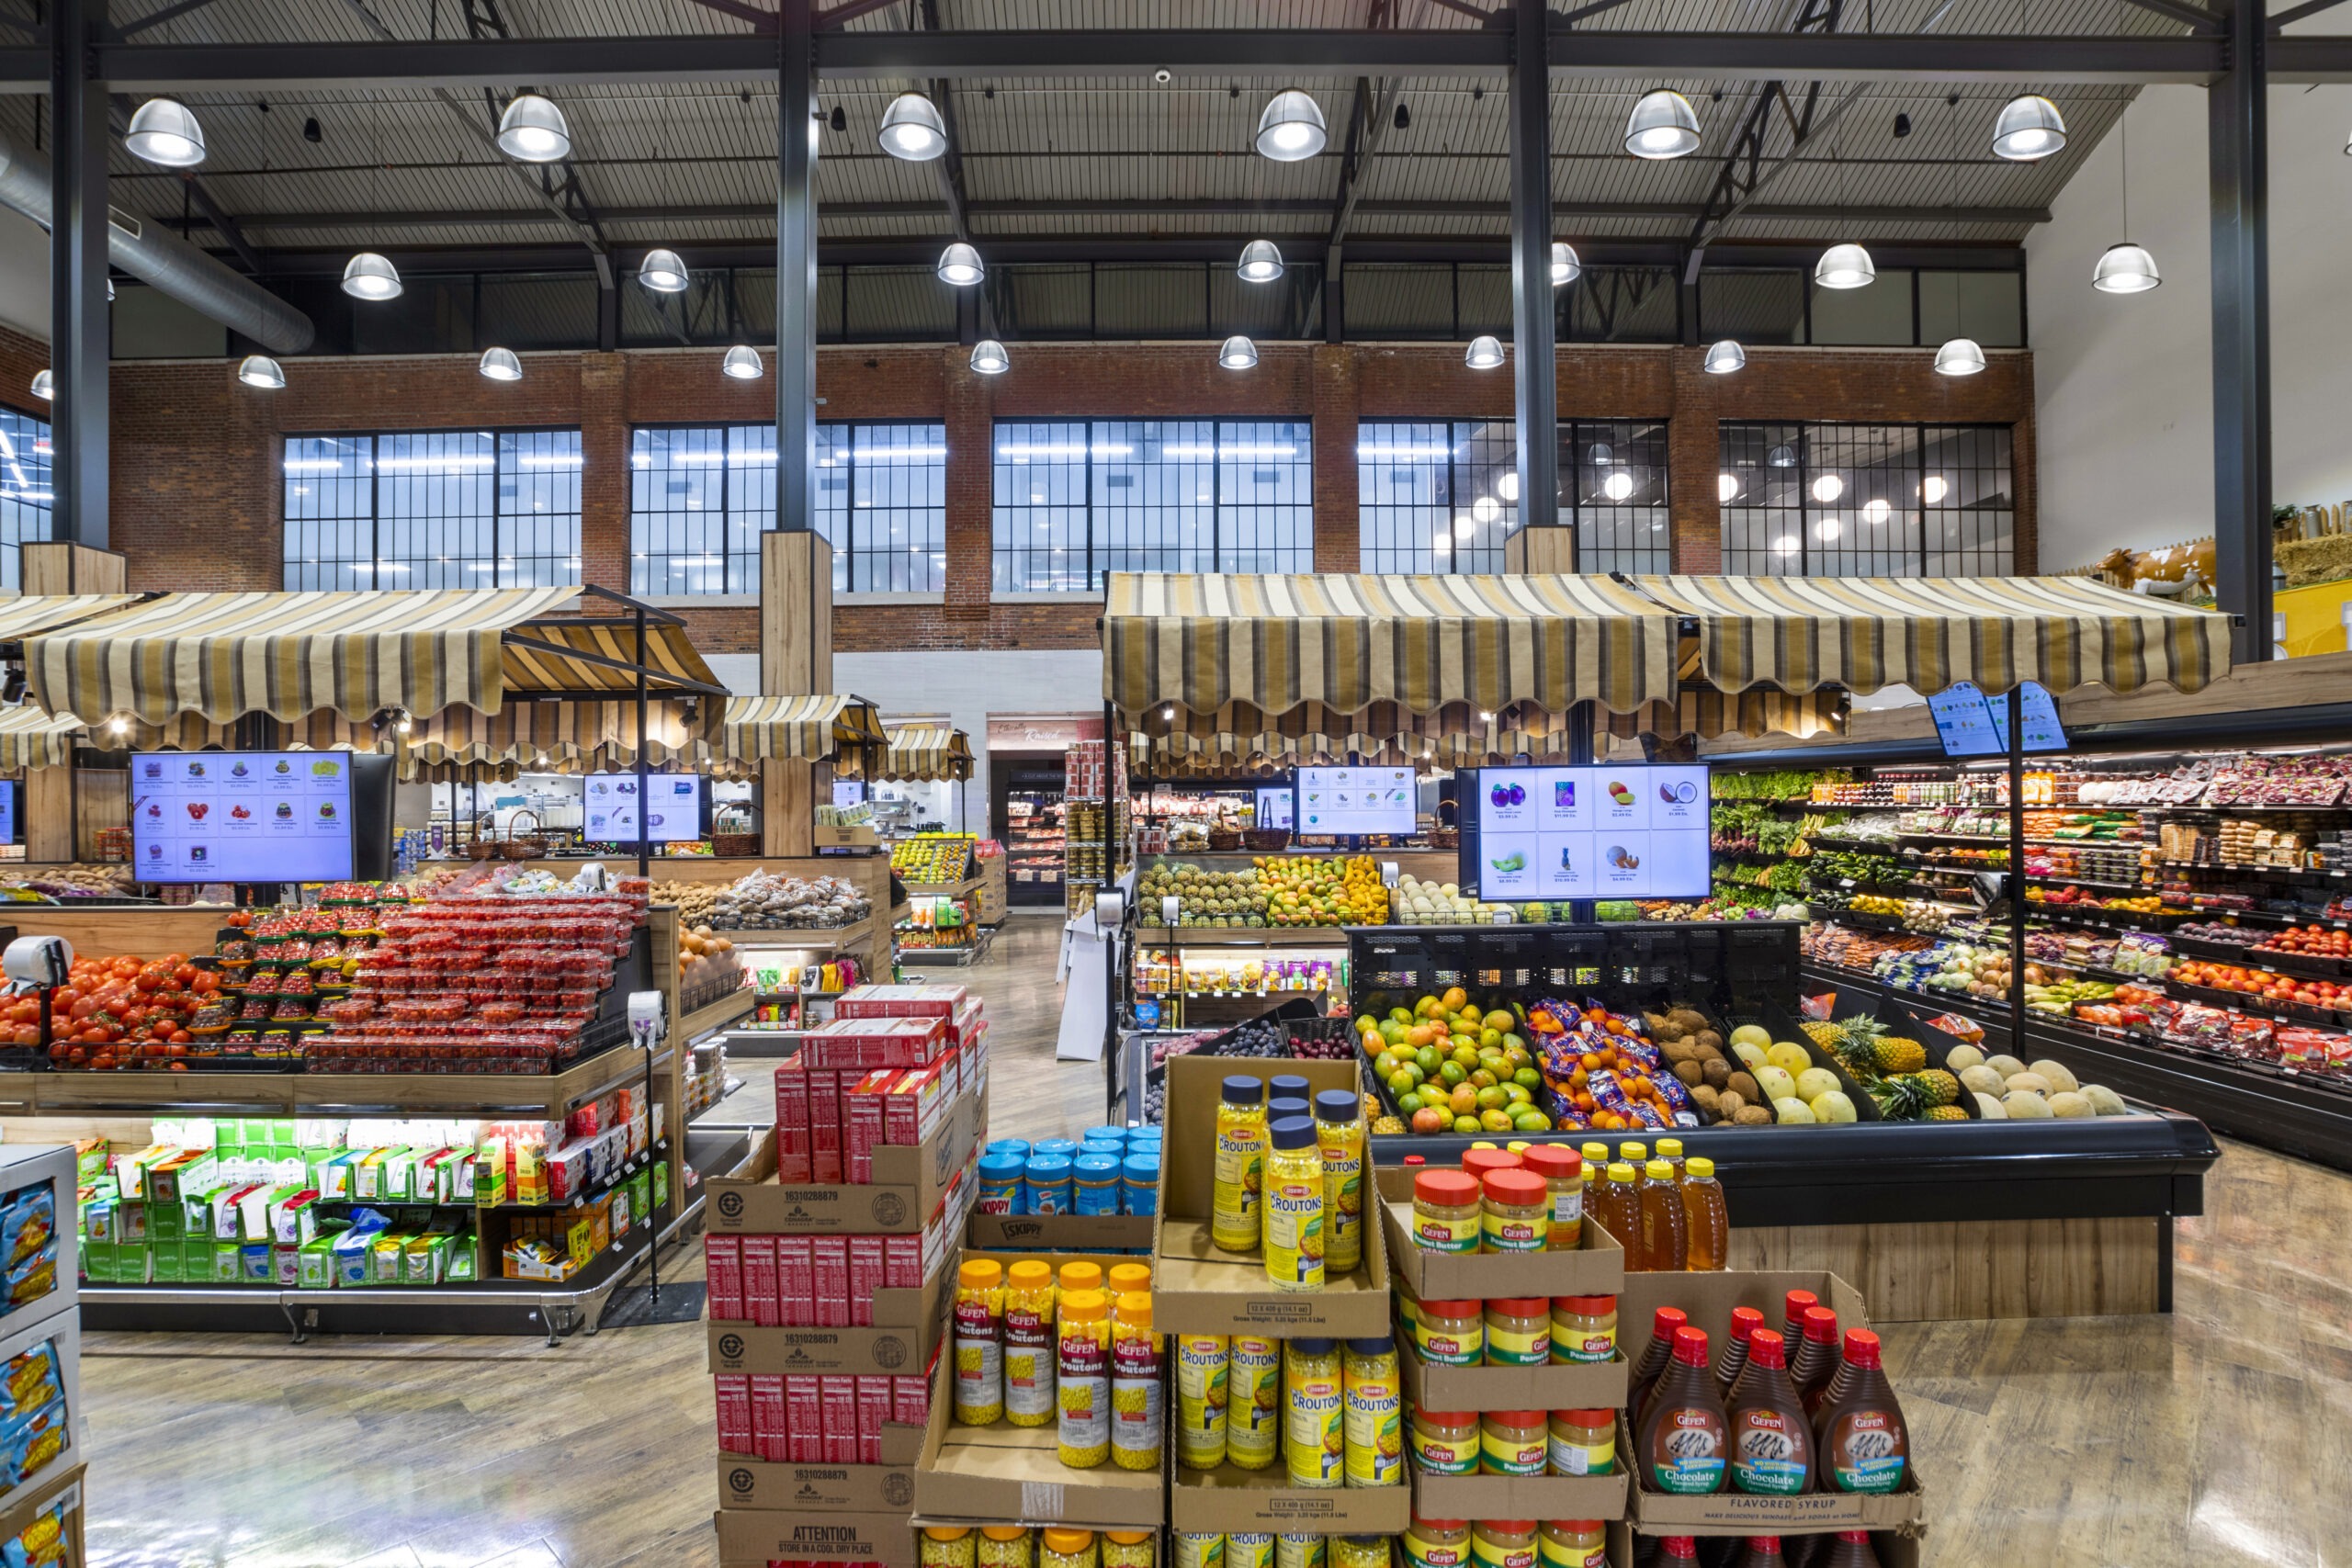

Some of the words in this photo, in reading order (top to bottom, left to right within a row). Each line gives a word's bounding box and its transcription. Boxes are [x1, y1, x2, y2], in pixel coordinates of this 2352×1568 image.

[1023, 729, 1060, 742] Raised
[1219, 1139, 1261, 1152] CROUTON
[1322, 1159, 1359, 1172] OUTONS
[785, 1191, 838, 1201] 16310288879
[980, 1200, 1010, 1215] KIPPY
[1271, 1195, 1322, 1211] CROUTONS
[1008, 1224, 1042, 1236] SKIPPY
[1423, 1227, 1449, 1238] GEFEN
[1504, 1228, 1531, 1238] GEFEN
[1436, 1241, 1462, 1249] Butter
[1490, 1237, 1517, 1248] Peanut
[1519, 1239, 1541, 1248] Butter
[957, 1305, 986, 1318] GEFEN
[1008, 1312, 1037, 1326] GEFEN
[785, 1334, 838, 1344] 16310288879
[1585, 1339, 1609, 1350] GEFEN
[1063, 1339, 1096, 1354] GEFEN
[1117, 1341, 1149, 1355] GEFEN
[1429, 1340, 1457, 1352] GEFEN
[1181, 1349, 1228, 1365] CROUTONS
[1232, 1351, 1277, 1366] CROUTONS
[1444, 1354, 1470, 1362] Butter
[1520, 1352, 1543, 1362] Peanut
[1570, 1350, 1595, 1360] Peanut
[1292, 1393, 1342, 1410] CROUTONS
[1347, 1393, 1399, 1411] CROUTONS
[1677, 1416, 1706, 1425] GEFEN
[1751, 1416, 1781, 1428] GEFEN
[1855, 1418, 1883, 1427] GEFEN
[1425, 1447, 1452, 1460] GEFEN
[1519, 1451, 1543, 1462] GEFEN
[1439, 1463, 1465, 1471] Butter
[1504, 1463, 1530, 1472] Peanut
[795, 1470, 847, 1480] 16310288879
[1665, 1472, 1715, 1481] Chocolate
[1741, 1470, 1794, 1485] Chocolate
[1847, 1471, 1895, 1483] Chocolate
[1731, 1499, 1791, 1508] FLAVORED
[1798, 1500, 1836, 1509] SYRUP
[793, 1526, 856, 1541] ATTENTION
[779, 1543, 800, 1553] STORE
[802, 1544, 809, 1553] IN
[811, 1544, 816, 1553] A
[817, 1544, 835, 1553] COOL
[837, 1544, 850, 1553] DRY
[852, 1544, 872, 1554] PLACE
[1429, 1553, 1455, 1562] GEFEN
[1507, 1555, 1531, 1566] GEFEN
